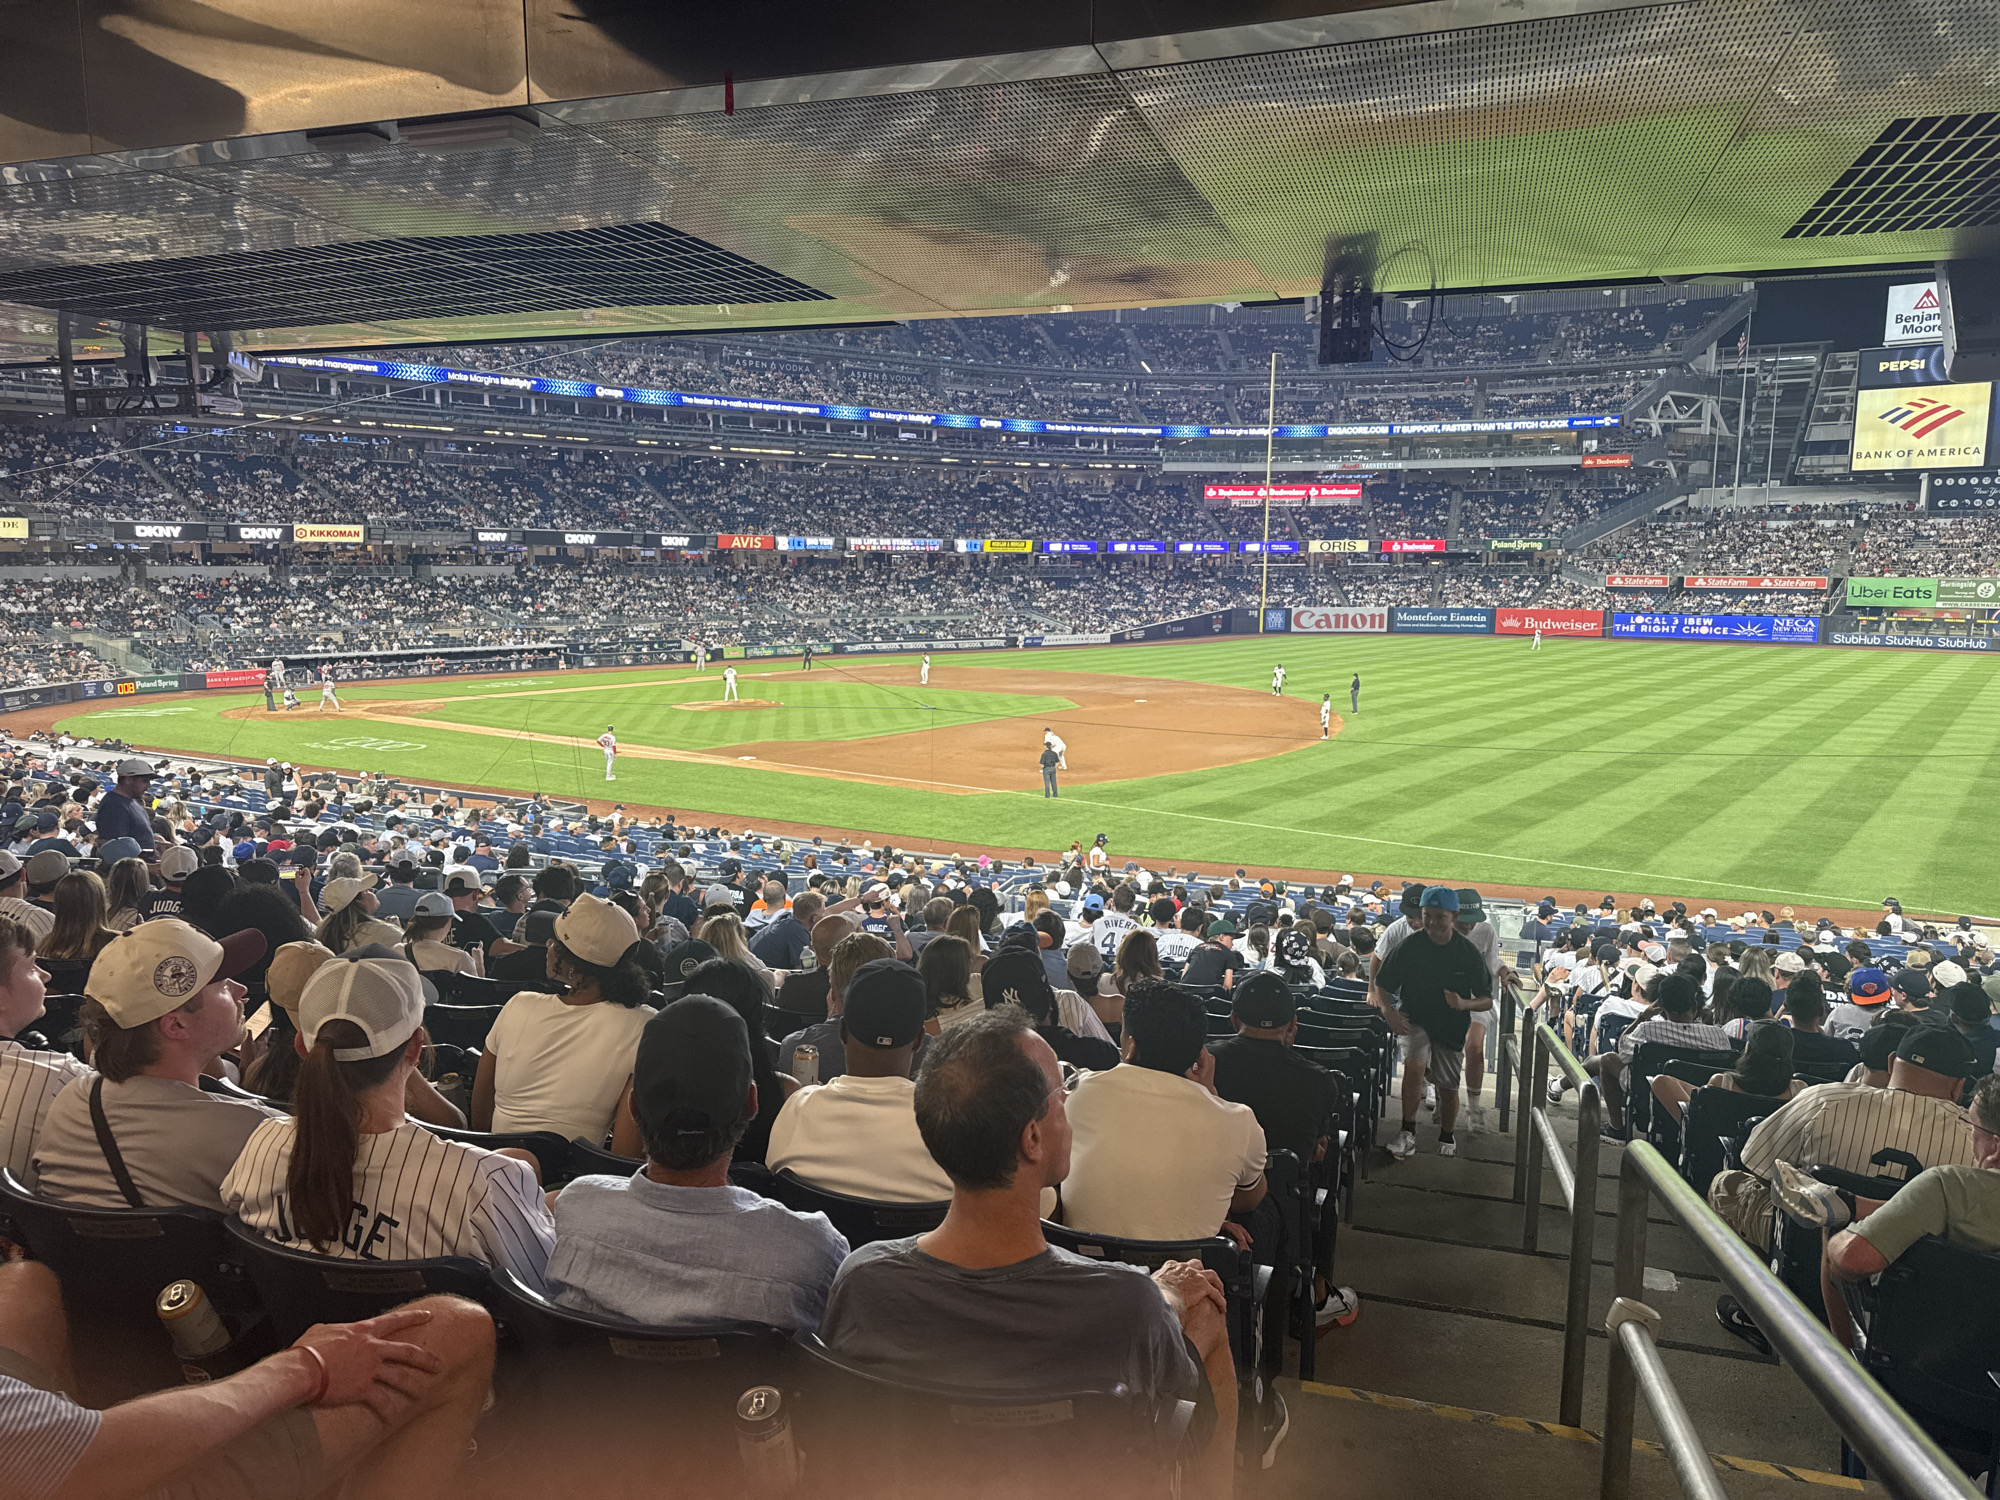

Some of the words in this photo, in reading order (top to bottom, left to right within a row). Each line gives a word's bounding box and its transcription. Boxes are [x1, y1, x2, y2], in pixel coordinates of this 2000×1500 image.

[324, 360, 378, 372] management
[735, 359, 768, 369] ASPEN
[779, 363, 810, 373] VODKA
[1879, 359, 1926, 372] PEPSI
[448, 371, 468, 381] Make
[469, 373, 500, 385] Margins
[850, 371, 879, 380] ASPEN
[890, 374, 918, 383] VODKA
[693, 397, 713, 405] leader
[869, 411, 885, 419] Make
[885, 412, 908, 422] Margins
[1225, 428, 1249, 437] Margins
[1393, 425, 1401, 434] IT
[1402, 424, 1440, 433] SUPPORT,
[1441, 423, 1472, 432] FASTER
[1471, 422, 1496, 431] THAN
[1496, 421, 1512, 430] THE
[1513, 420, 1539, 430] PITCH
[1539, 419, 1569, 428] CLOCK
[1856, 451, 1892, 460] BANK
[1896, 449, 1914, 458] OF
[1917, 446, 1981, 458] AMERICA
[1218, 488, 1255, 496] Budweiser
[1269, 488, 1307, 496] Budweiser
[1320, 487, 1360, 495] Budweiser
[135, 525, 182, 538] DKNY
[240, 527, 282, 539] DKNY
[310, 529, 360, 538] KIKKOMAN
[478, 531, 507, 542] DKNY
[564, 533, 596, 545] DKNY
[661, 535, 690, 547] DKNY
[731, 536, 762, 549] AVIS
[1491, 540, 1516, 550] Poland
[1517, 540, 1543, 550] Spring
[1320, 541, 1357, 552] ORIS
[1402, 542, 1436, 550] Budweiser
[1940, 580, 1977, 589] Morningside
[1851, 586, 1889, 599] Uber
[1893, 587, 1933, 599] Eats
[1292, 609, 1386, 630] Canon
[1397, 612, 1448, 621] Montefiore
[1450, 612, 1487, 622] Einstein
[1630, 615, 1667, 625] LOCAL
[1672, 617, 1679, 625] 3
[1684, 617, 1713, 626] IBEW
[1774, 618, 1816, 628] NECA
[1524, 617, 1598, 631] Budweiser
[1615, 623, 1636, 632] THE
[1640, 624, 1676, 634] RIGHT
[1682, 625, 1729, 635] CHOICE
[1833, 634, 1881, 645] StubHub
[1885, 635, 1933, 647] StubHub
[1937, 637, 1987, 649] StubHub
[136, 680, 157, 690] Poland
[158, 679, 179, 689] Spring
[150, 900, 182, 914] JUDG
[1167, 943, 1193, 958] JUDG
[273, 1194, 400, 1261] JGE
